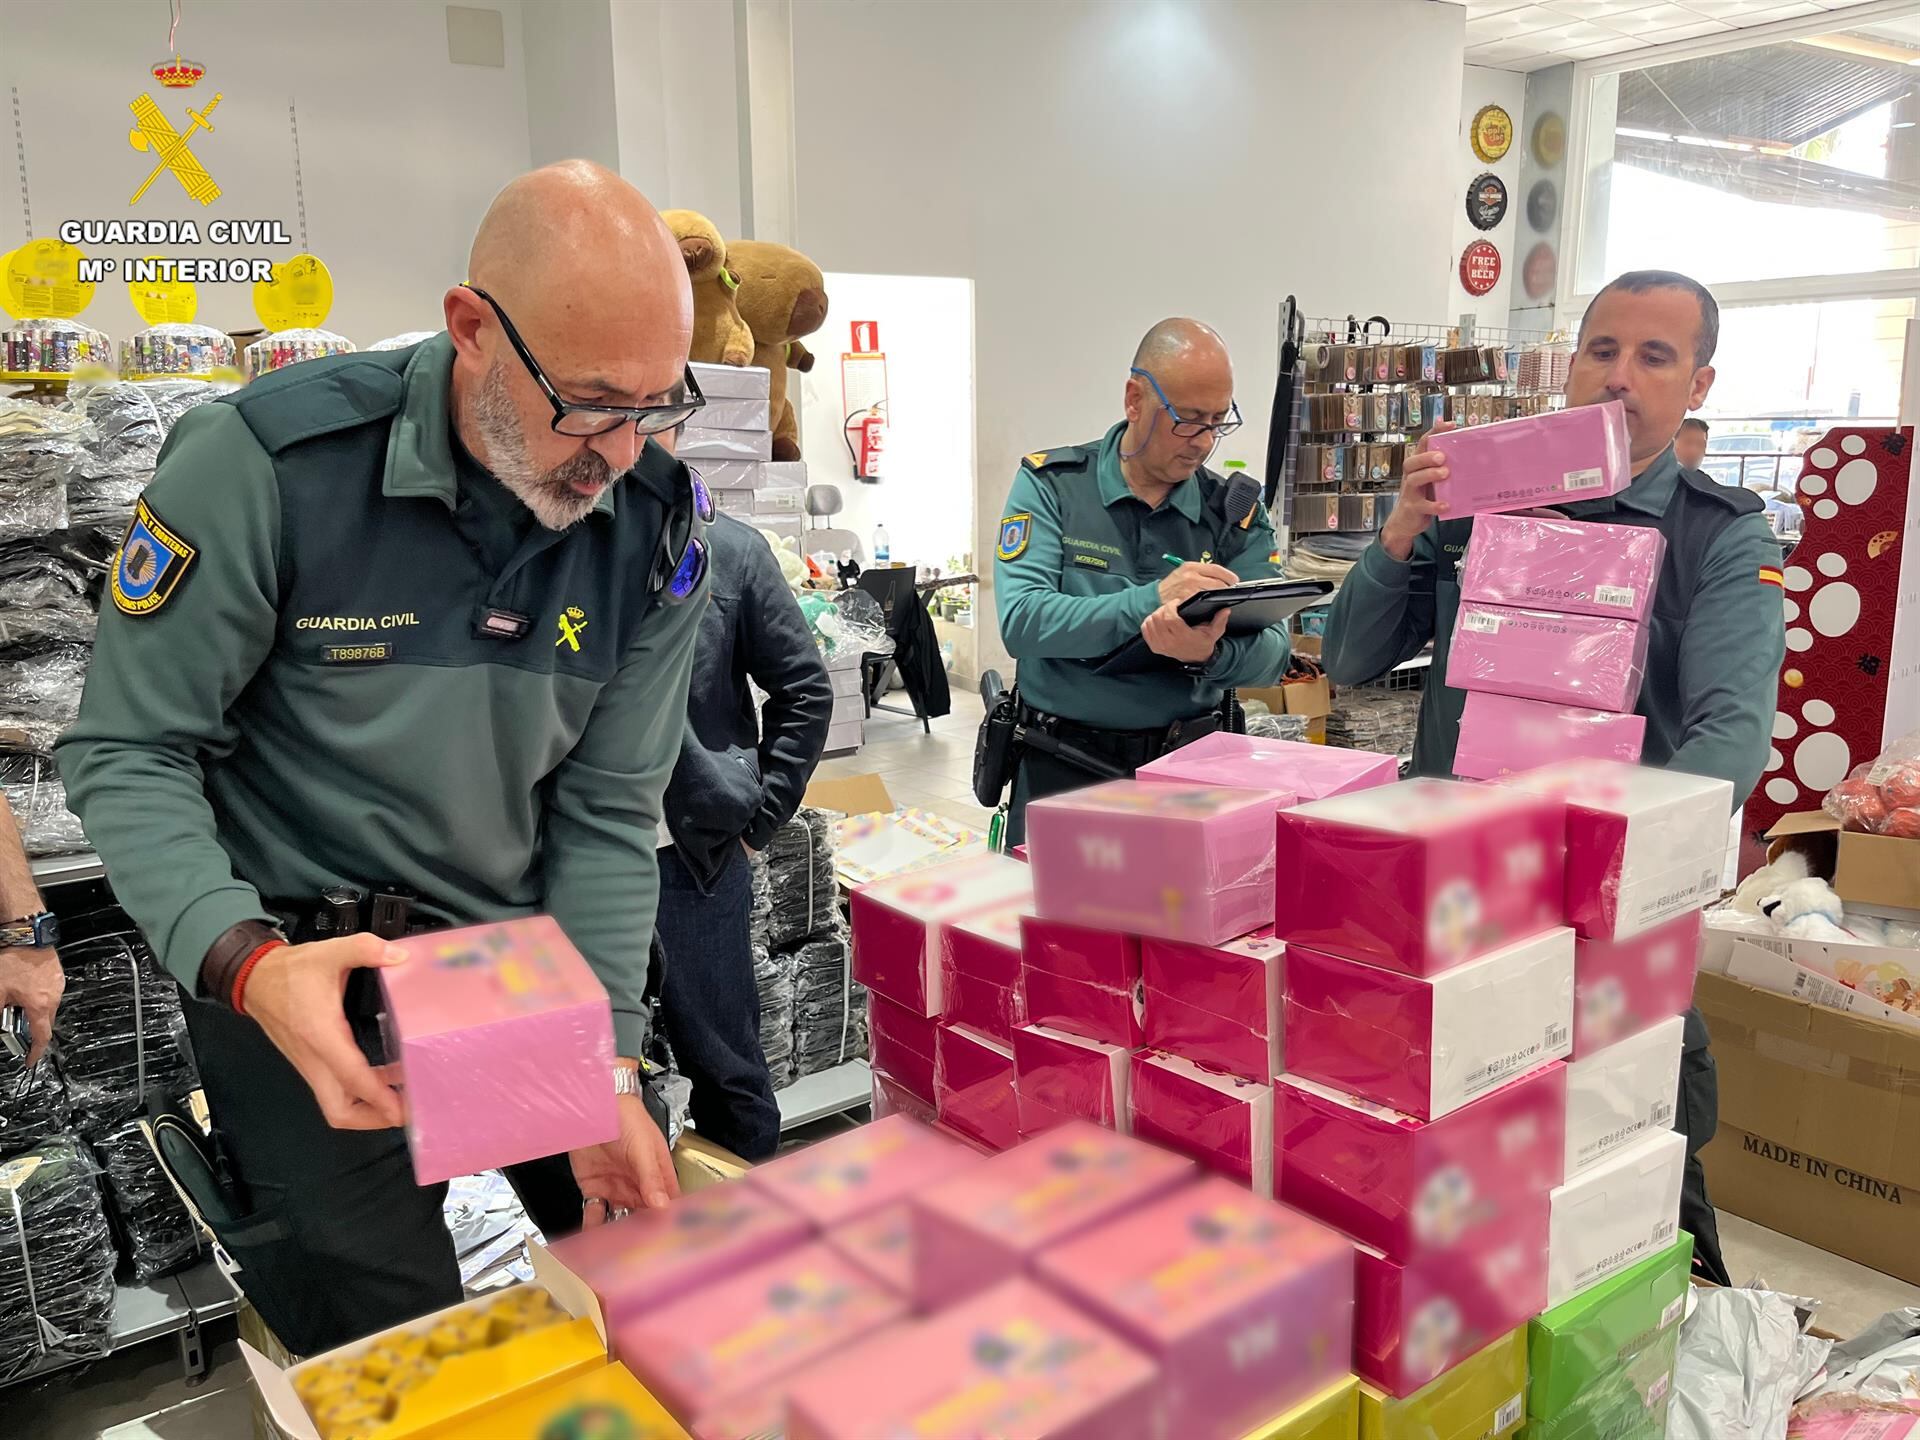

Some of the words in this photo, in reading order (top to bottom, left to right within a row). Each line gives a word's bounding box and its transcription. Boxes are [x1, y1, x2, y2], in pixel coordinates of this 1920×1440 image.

[1472, 256, 1496, 267] FREE
[1471, 269, 1495, 279] BEER
[147, 521, 154, 529] Y
[152, 525, 189, 558] FRONTERAS
[1062, 536, 1100, 551] GUARDIA
[1443, 544, 1465, 553] GUA
[137, 591, 162, 610] POLICE
[296, 616, 377, 631] GUARDIA
[380, 612, 420, 629] CIVIL
[331, 647, 386, 660] T89876B
[1743, 1134, 1801, 1169] MADE
[1806, 1156, 1829, 1179] IN
[1834, 1168, 1903, 1205] CHINA
